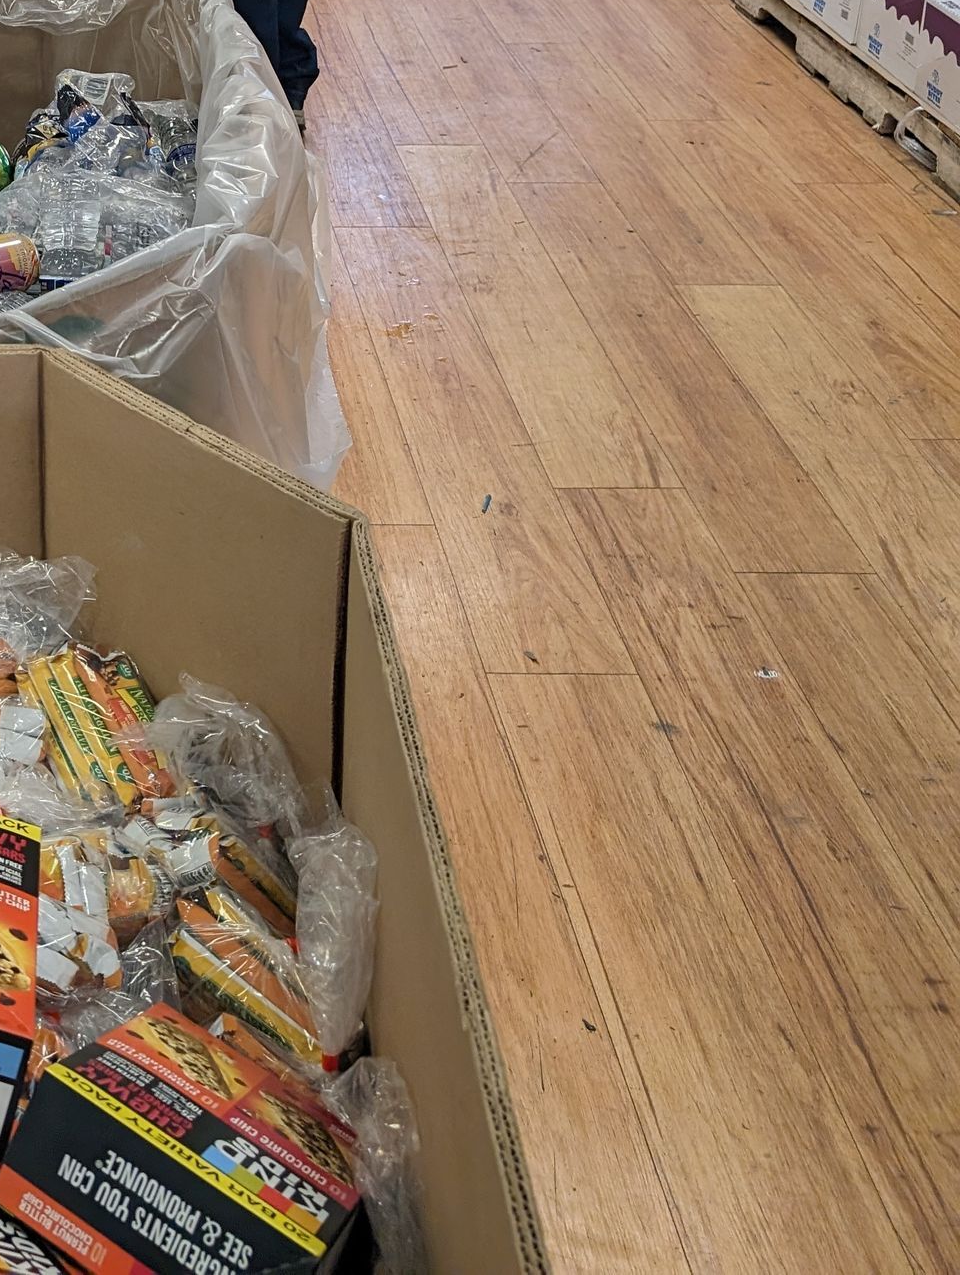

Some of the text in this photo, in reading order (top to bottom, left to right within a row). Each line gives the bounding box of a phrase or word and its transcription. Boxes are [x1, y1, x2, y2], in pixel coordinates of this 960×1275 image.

[868, 34, 883, 49] MUDDY
[926, 81, 943, 97] MUDDY
[5, 857, 23, 870] FREE
[57, 1153, 96, 1192] CAN
[61, 1071, 310, 1243] 20 BAR VARIETY PACK
[95, 1178, 131, 1220] YOU
[213, 1139, 330, 1224] KIND
[18, 1199, 105, 1265] 10 PEANUT BUTTER
[202, 1218, 223, 1245] &
[219, 1239, 253, 1270] SEE
